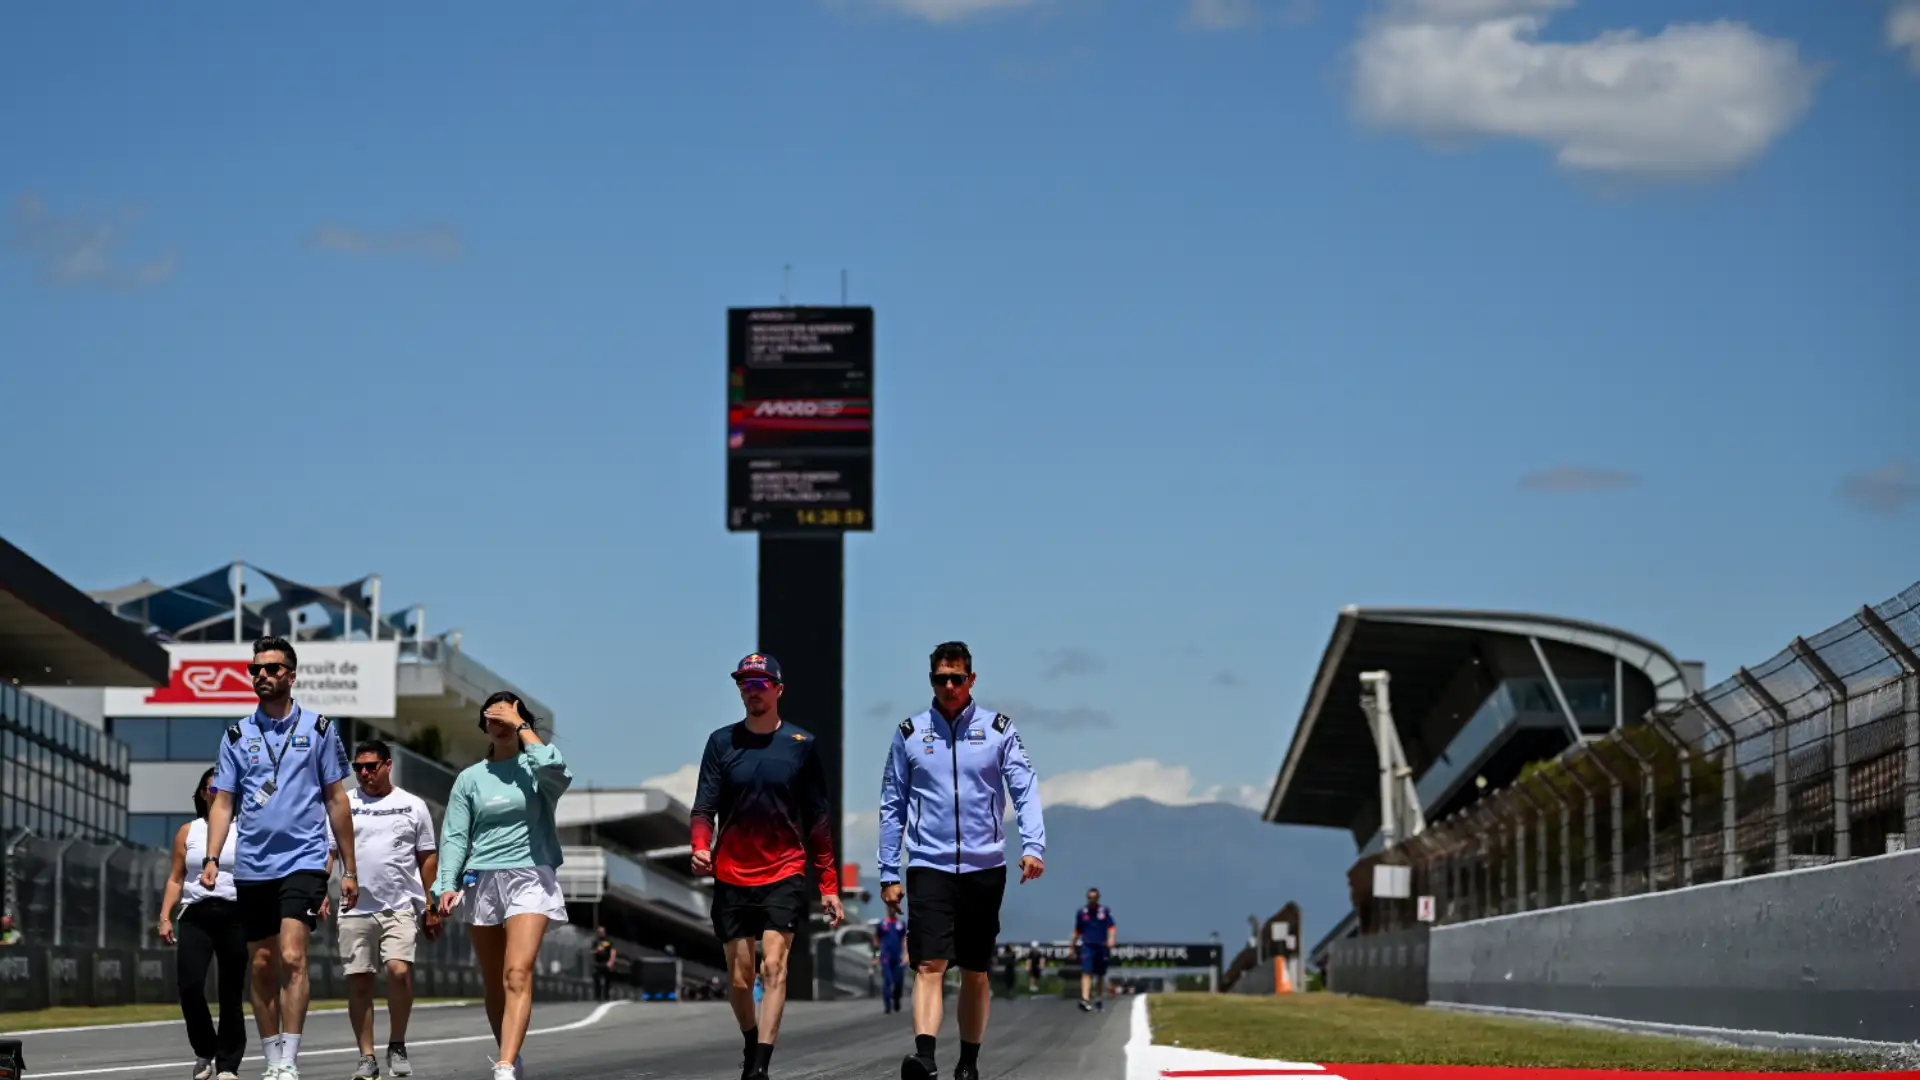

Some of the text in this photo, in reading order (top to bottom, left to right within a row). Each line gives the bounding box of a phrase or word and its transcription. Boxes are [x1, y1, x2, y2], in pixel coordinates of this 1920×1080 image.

[297, 660, 358, 674] rcuit de
[293, 677, 358, 690] arcelona
